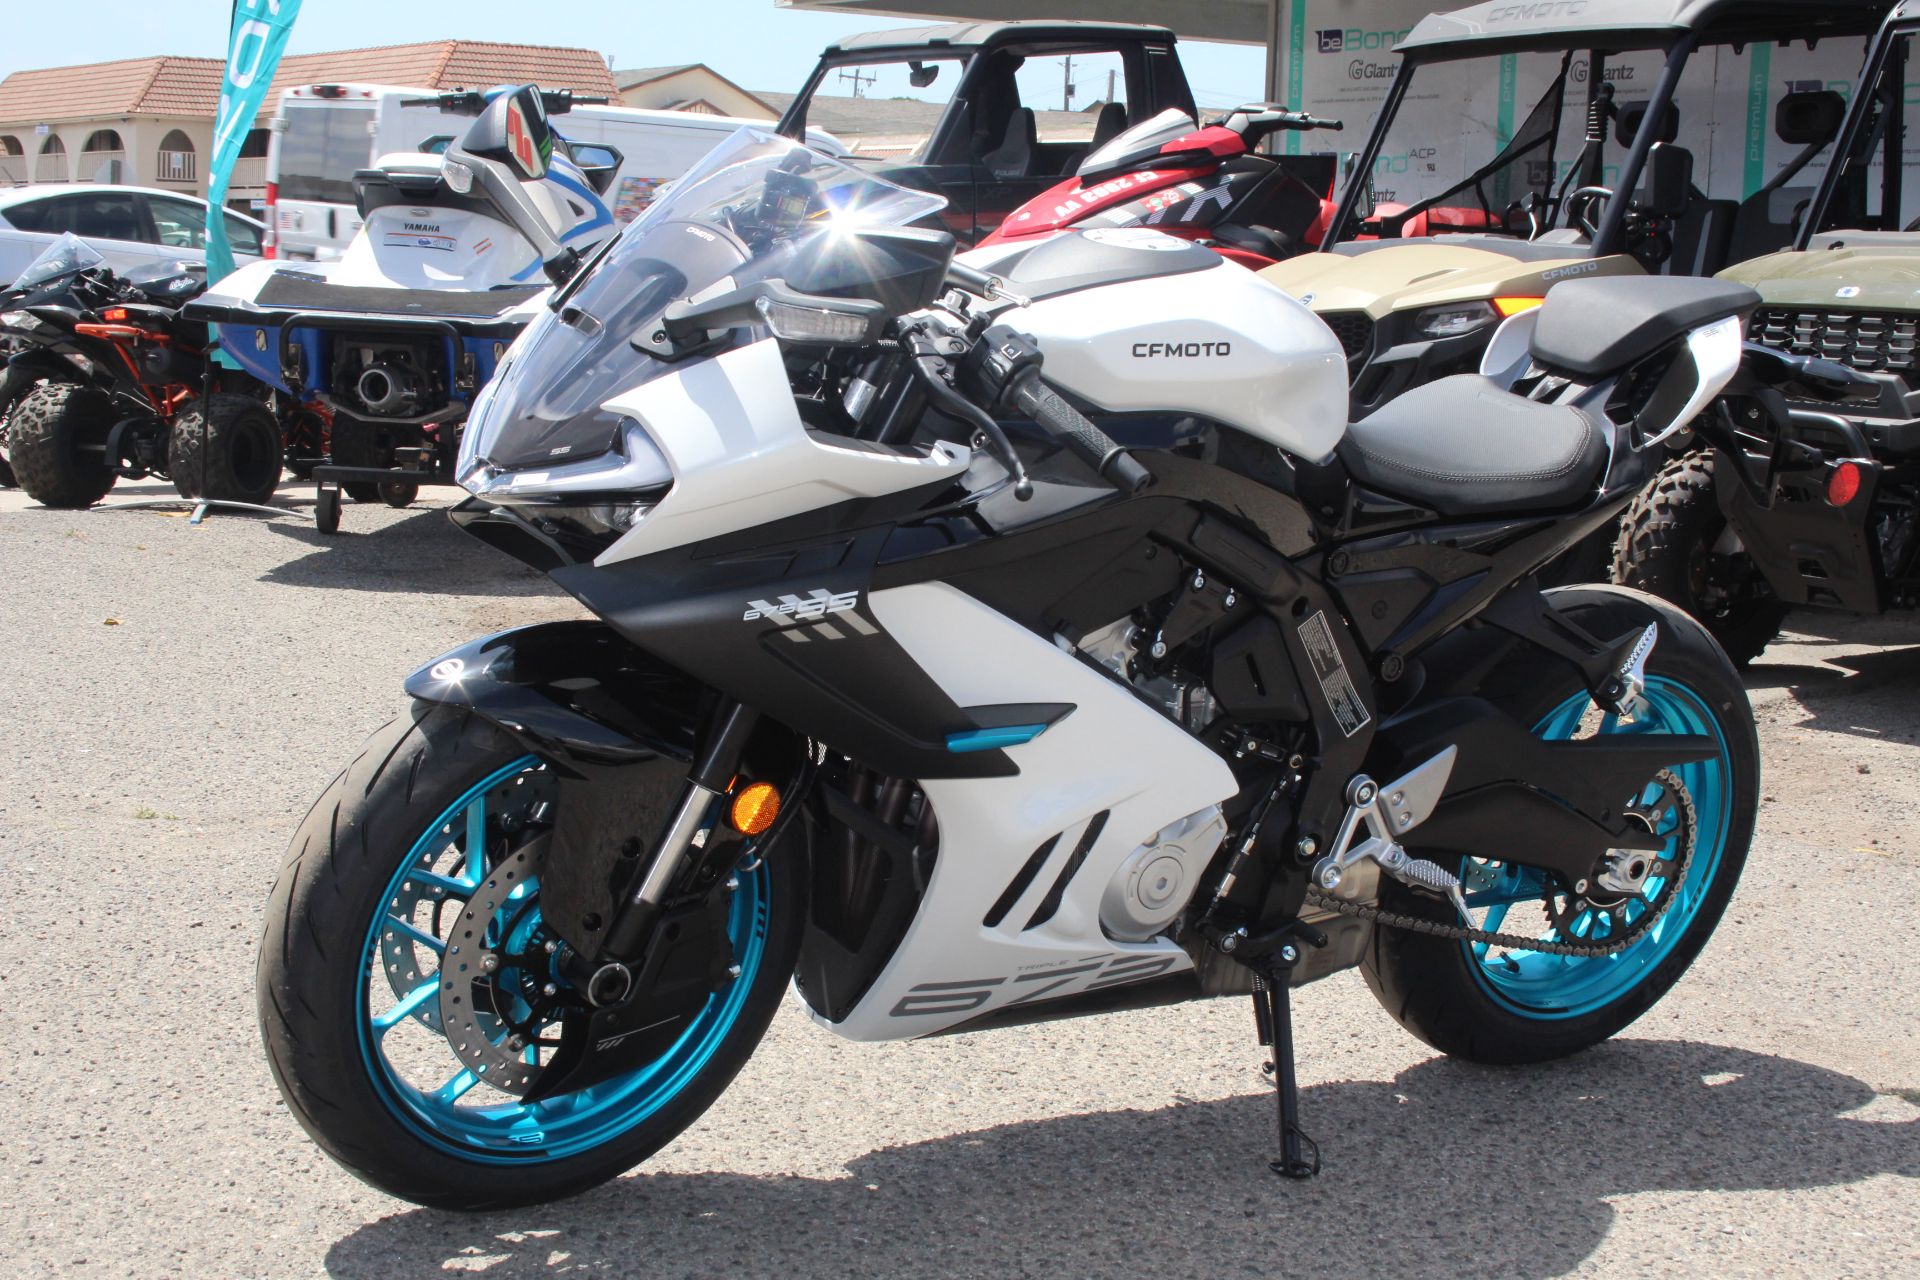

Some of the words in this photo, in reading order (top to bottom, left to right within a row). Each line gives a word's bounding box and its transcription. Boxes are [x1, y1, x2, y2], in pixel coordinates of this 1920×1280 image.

[1751, 73, 1763, 161] premium
[1409, 148, 1436, 159] ACP
[404, 222, 440, 233] YAMAHA
[1542, 261, 1598, 281] CFMOTO
[1132, 342, 1231, 358] CFMOTO
